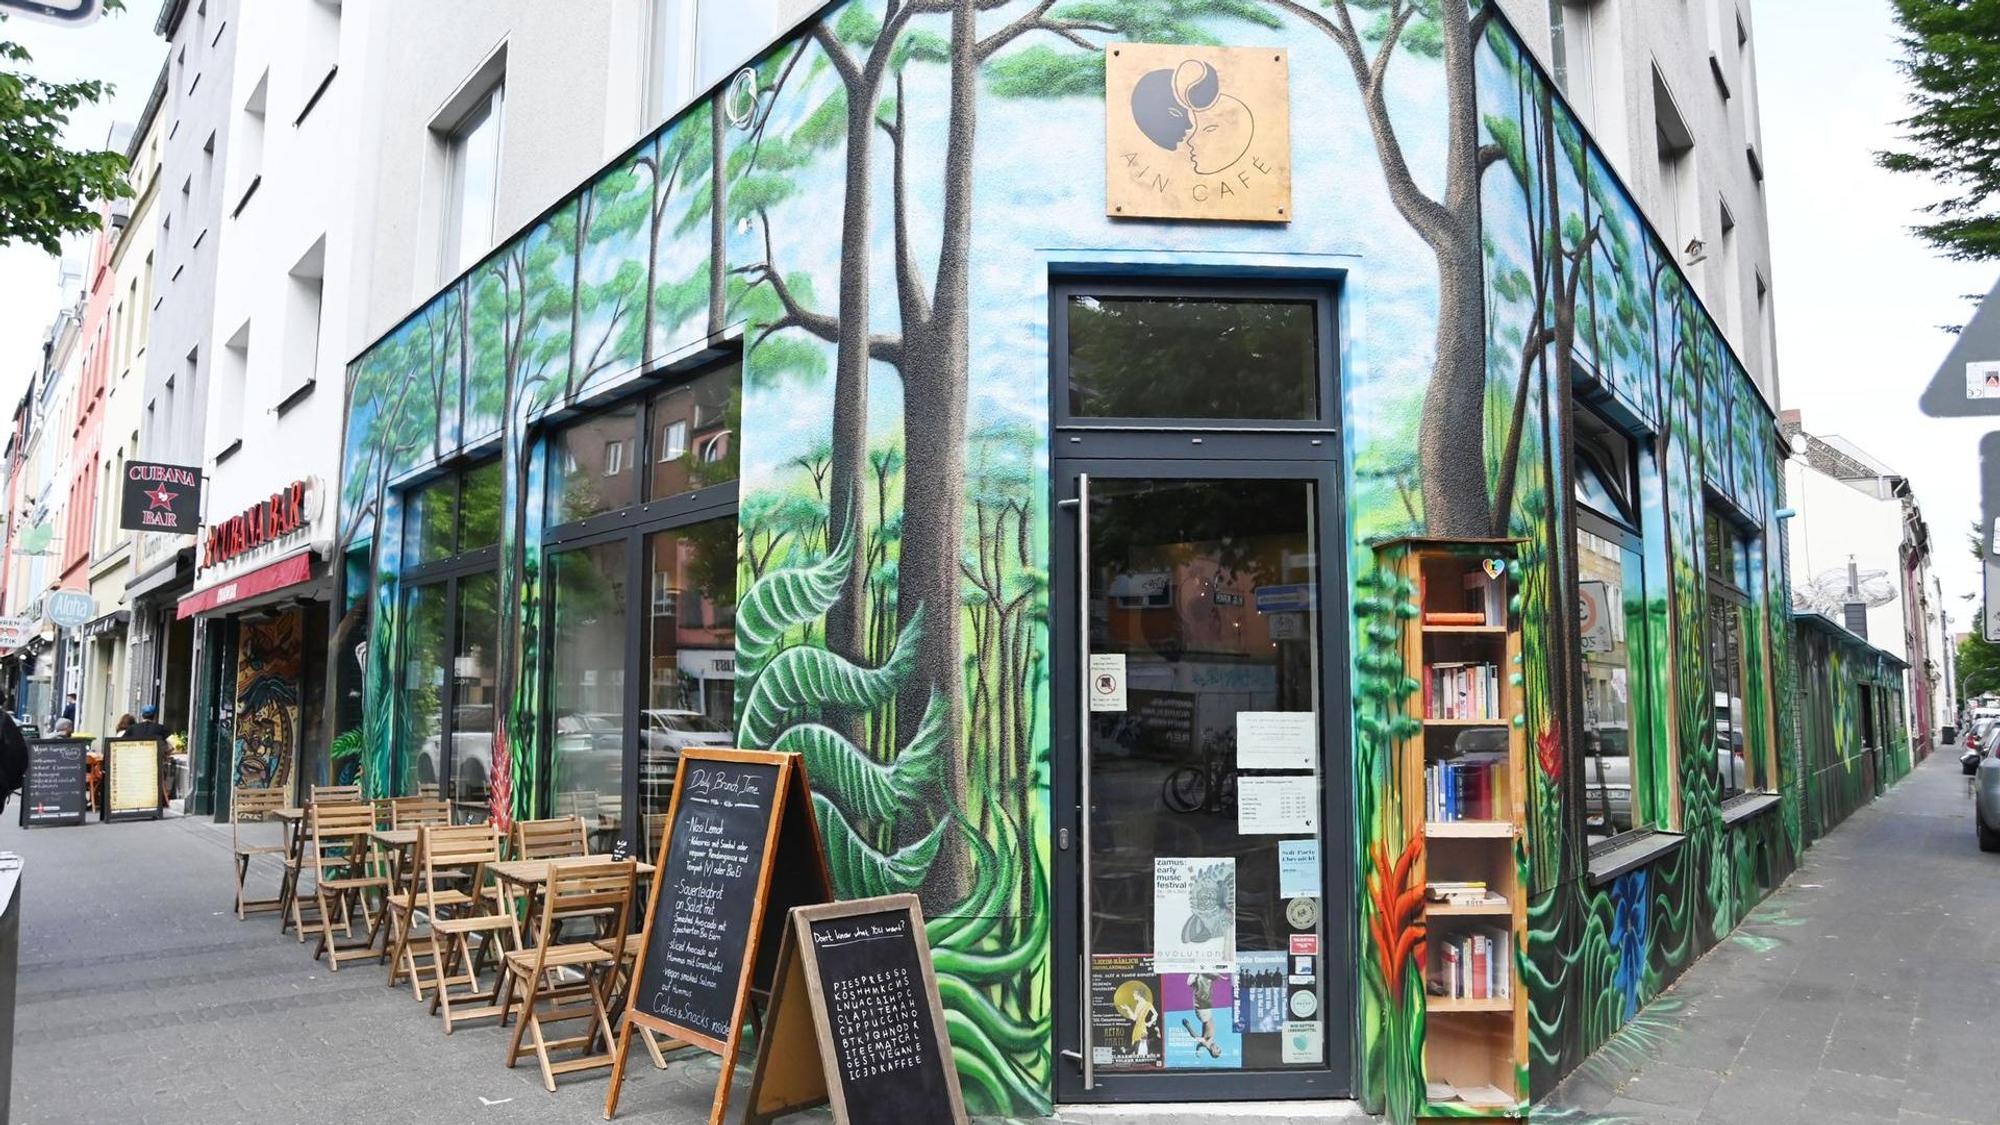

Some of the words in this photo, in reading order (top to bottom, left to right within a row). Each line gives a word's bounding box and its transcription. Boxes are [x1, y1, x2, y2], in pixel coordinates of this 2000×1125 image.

[1120, 151, 1169, 193] AIN
[129, 465, 196, 487] CUBANA
[142, 510, 178, 527] BAR
[215, 501, 267, 563] CUBANA
[270, 480, 304, 541] BAR
[1156, 866, 1177, 875] early
[1156, 881, 1187, 889] festival
